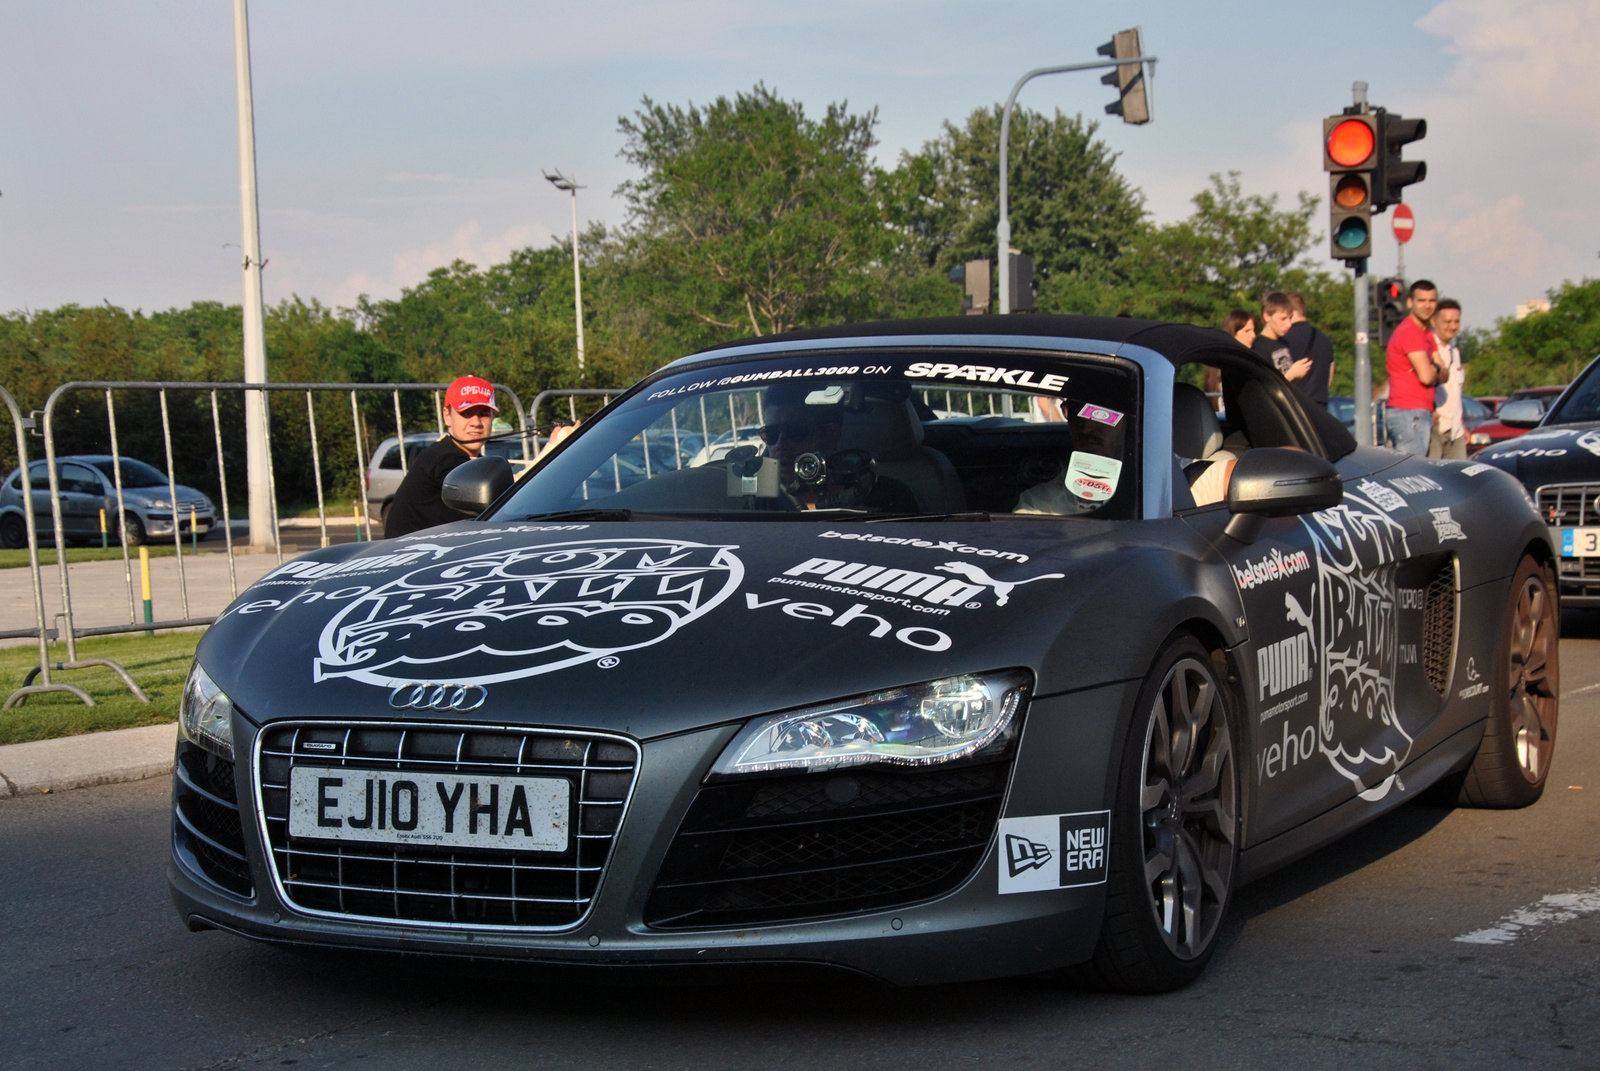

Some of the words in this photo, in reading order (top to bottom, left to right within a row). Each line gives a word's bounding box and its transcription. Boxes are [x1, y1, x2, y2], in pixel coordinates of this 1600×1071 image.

[647, 379, 717, 401] FOLLOW
[717, 366, 860, 387] @GUMBALL3000
[862, 365, 892, 375] ON
[904, 362, 1070, 392] SPARKLE
[767, 575, 951, 617] pumamotorsport.com
[783, 557, 987, 607] PUMA
[745, 592, 953, 652] veho
[1257, 631, 1309, 702] PUMA
[1260, 691, 1309, 725] pumamotorsport.com
[1256, 720, 1316, 787] veho
[317, 777, 419, 831] EJ10
[436, 781, 533, 837] YHA
[1066, 827, 1105, 851] NEW
[1066, 848, 1104, 872] ERA
